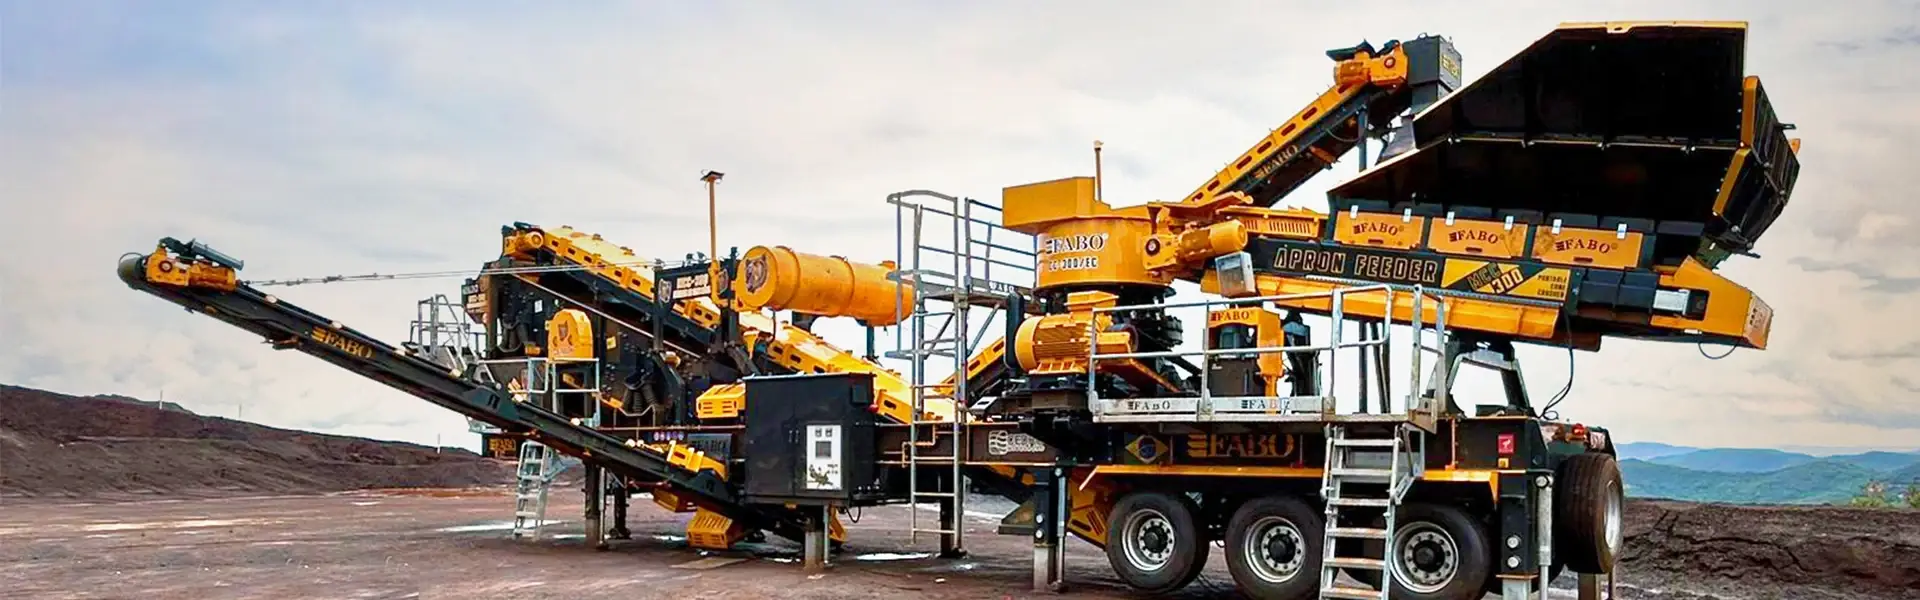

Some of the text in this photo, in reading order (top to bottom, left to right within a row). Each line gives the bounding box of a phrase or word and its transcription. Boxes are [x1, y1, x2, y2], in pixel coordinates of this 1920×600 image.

[1361, 222, 1398, 236] FABO
[1457, 229, 1499, 244] FABO
[1052, 234, 1104, 253] FABO
[1564, 238, 1611, 254] FABO
[1274, 247, 1438, 283] APRON FEEDER
[1466, 262, 1501, 290] MCC
[1492, 267, 1524, 294] 300
[1217, 310, 1250, 321] FABO
[323, 331, 373, 359] FABO
[1209, 433, 1295, 458] FABO
